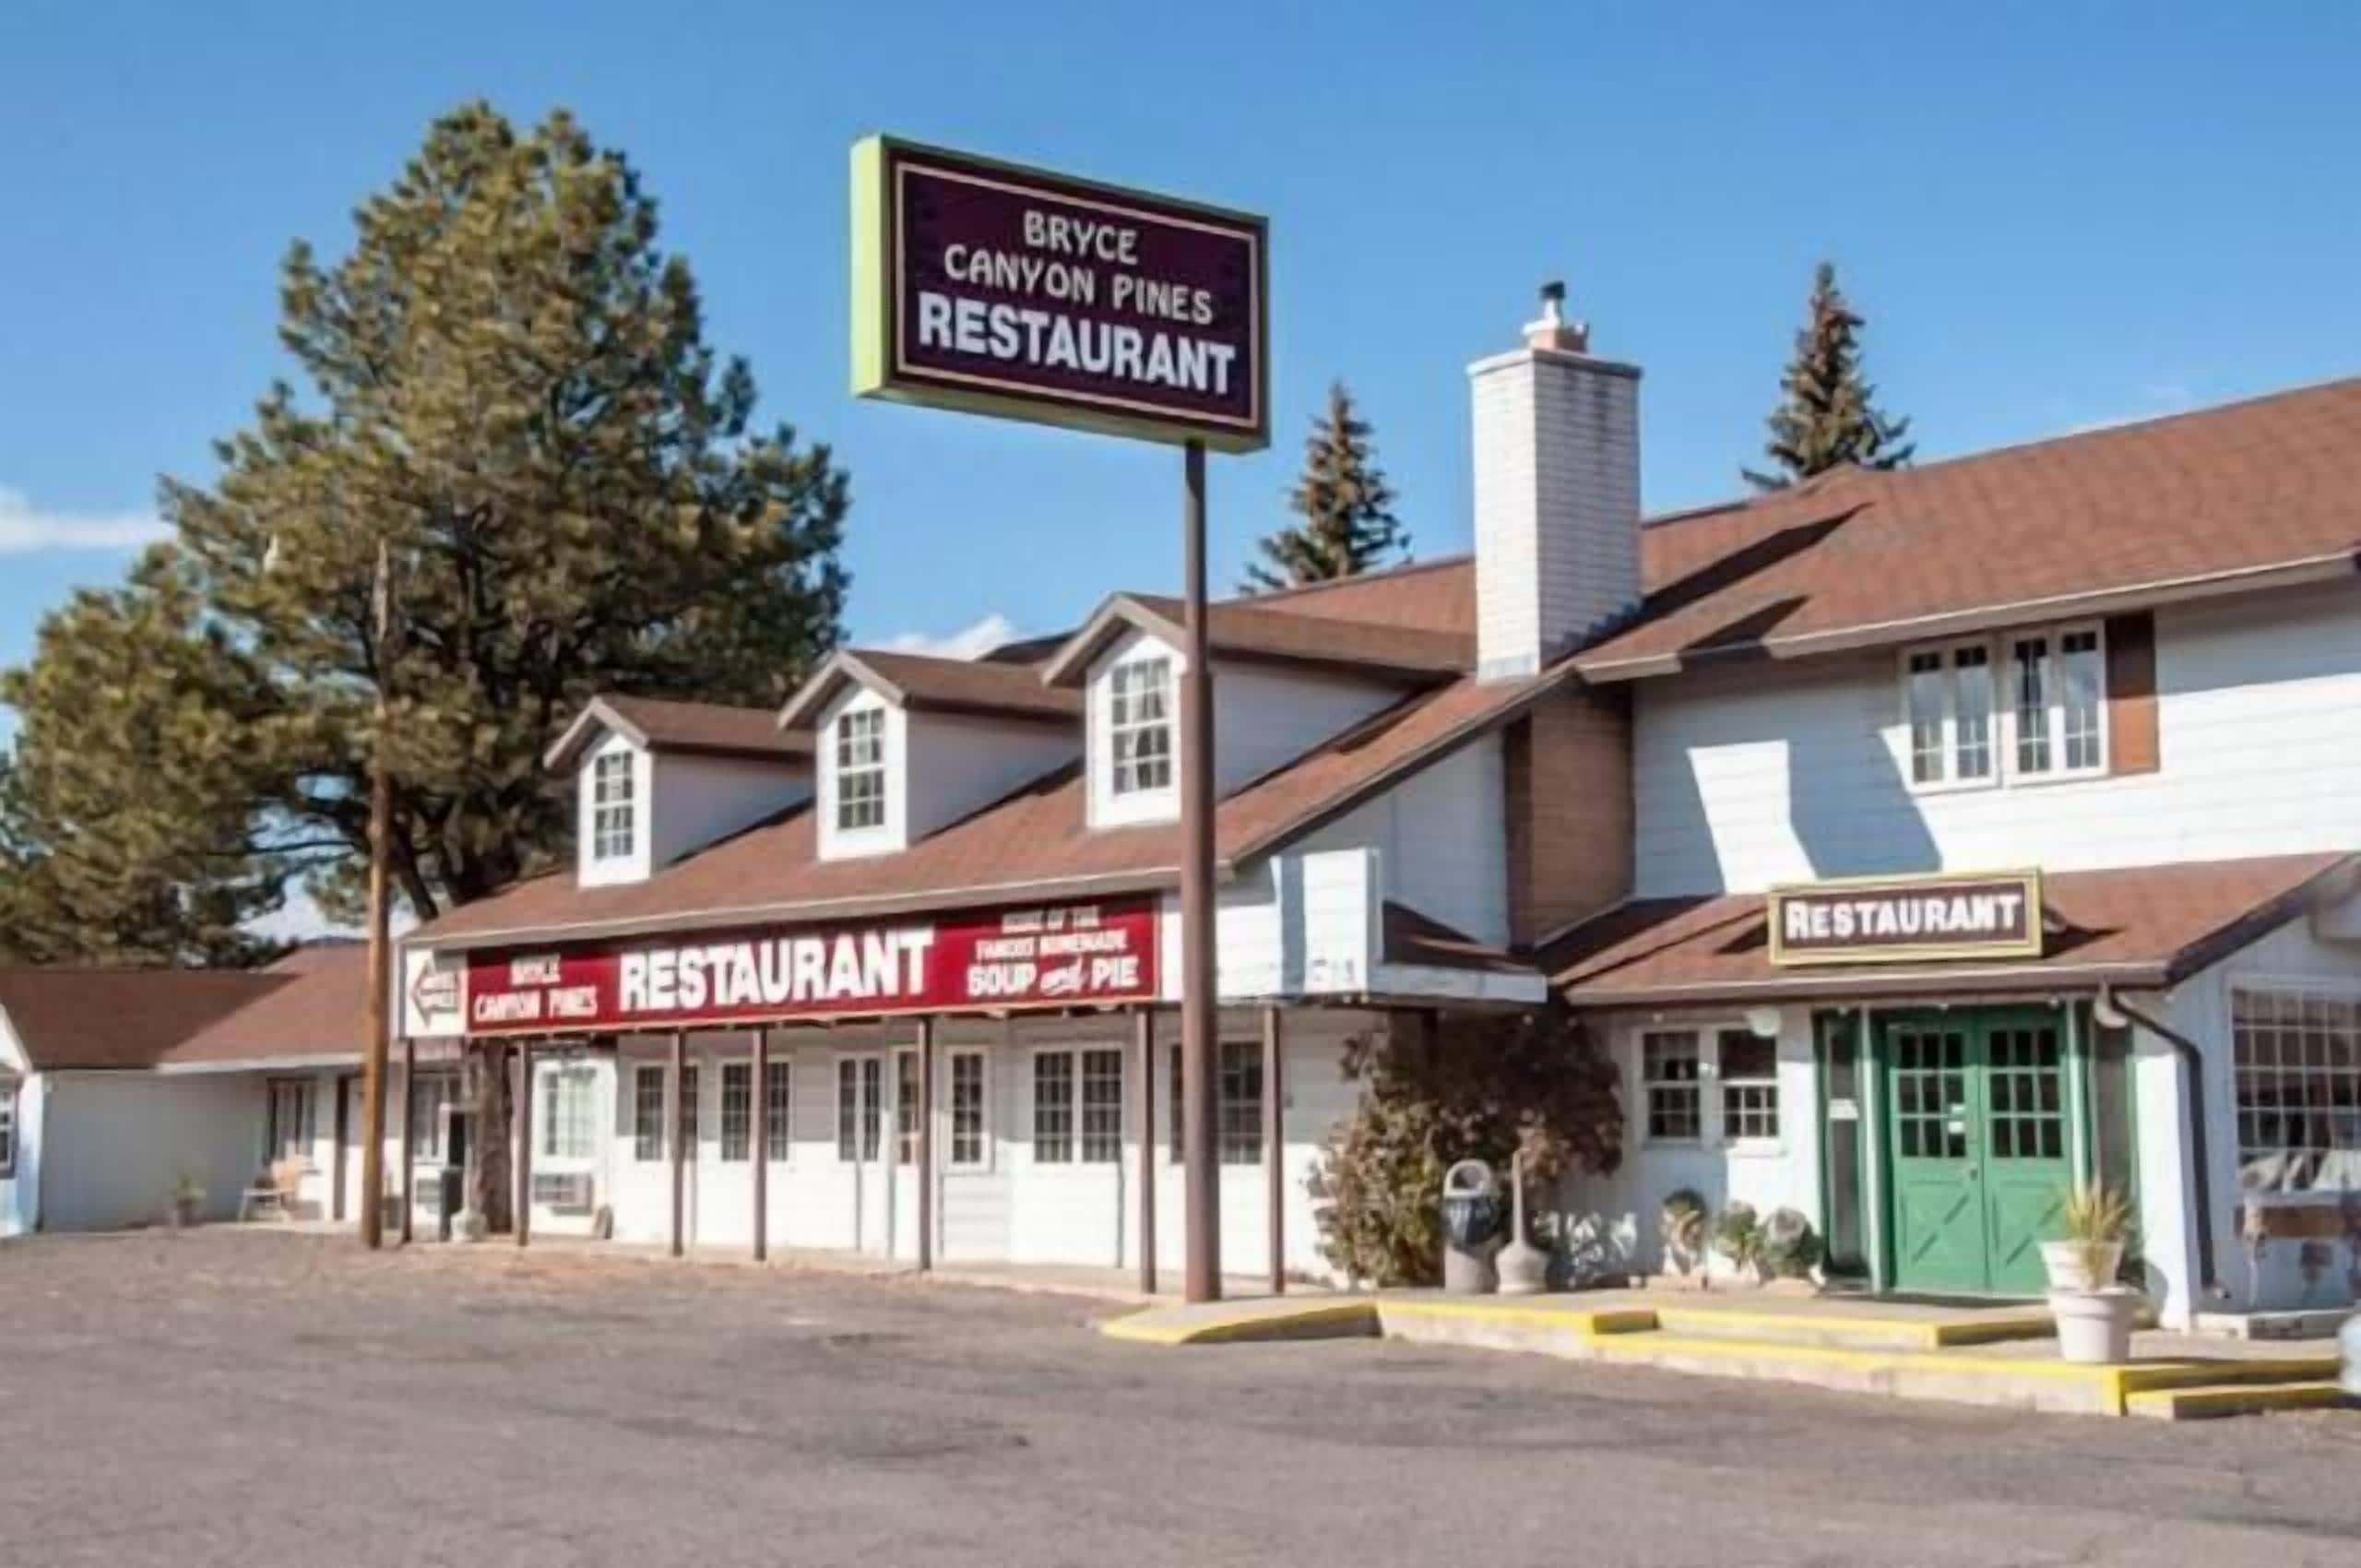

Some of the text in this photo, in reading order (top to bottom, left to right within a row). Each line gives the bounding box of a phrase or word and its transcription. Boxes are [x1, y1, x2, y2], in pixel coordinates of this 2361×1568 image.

[1024, 209, 1139, 266] BRYCE
[943, 244, 1213, 325] CANYON PINES
[919, 291, 1237, 396] RESTAURANT
[619, 928, 934, 1012] RESTAURANT
[967, 962, 1037, 997] SOUP
[1091, 956, 1140, 990] PIE
